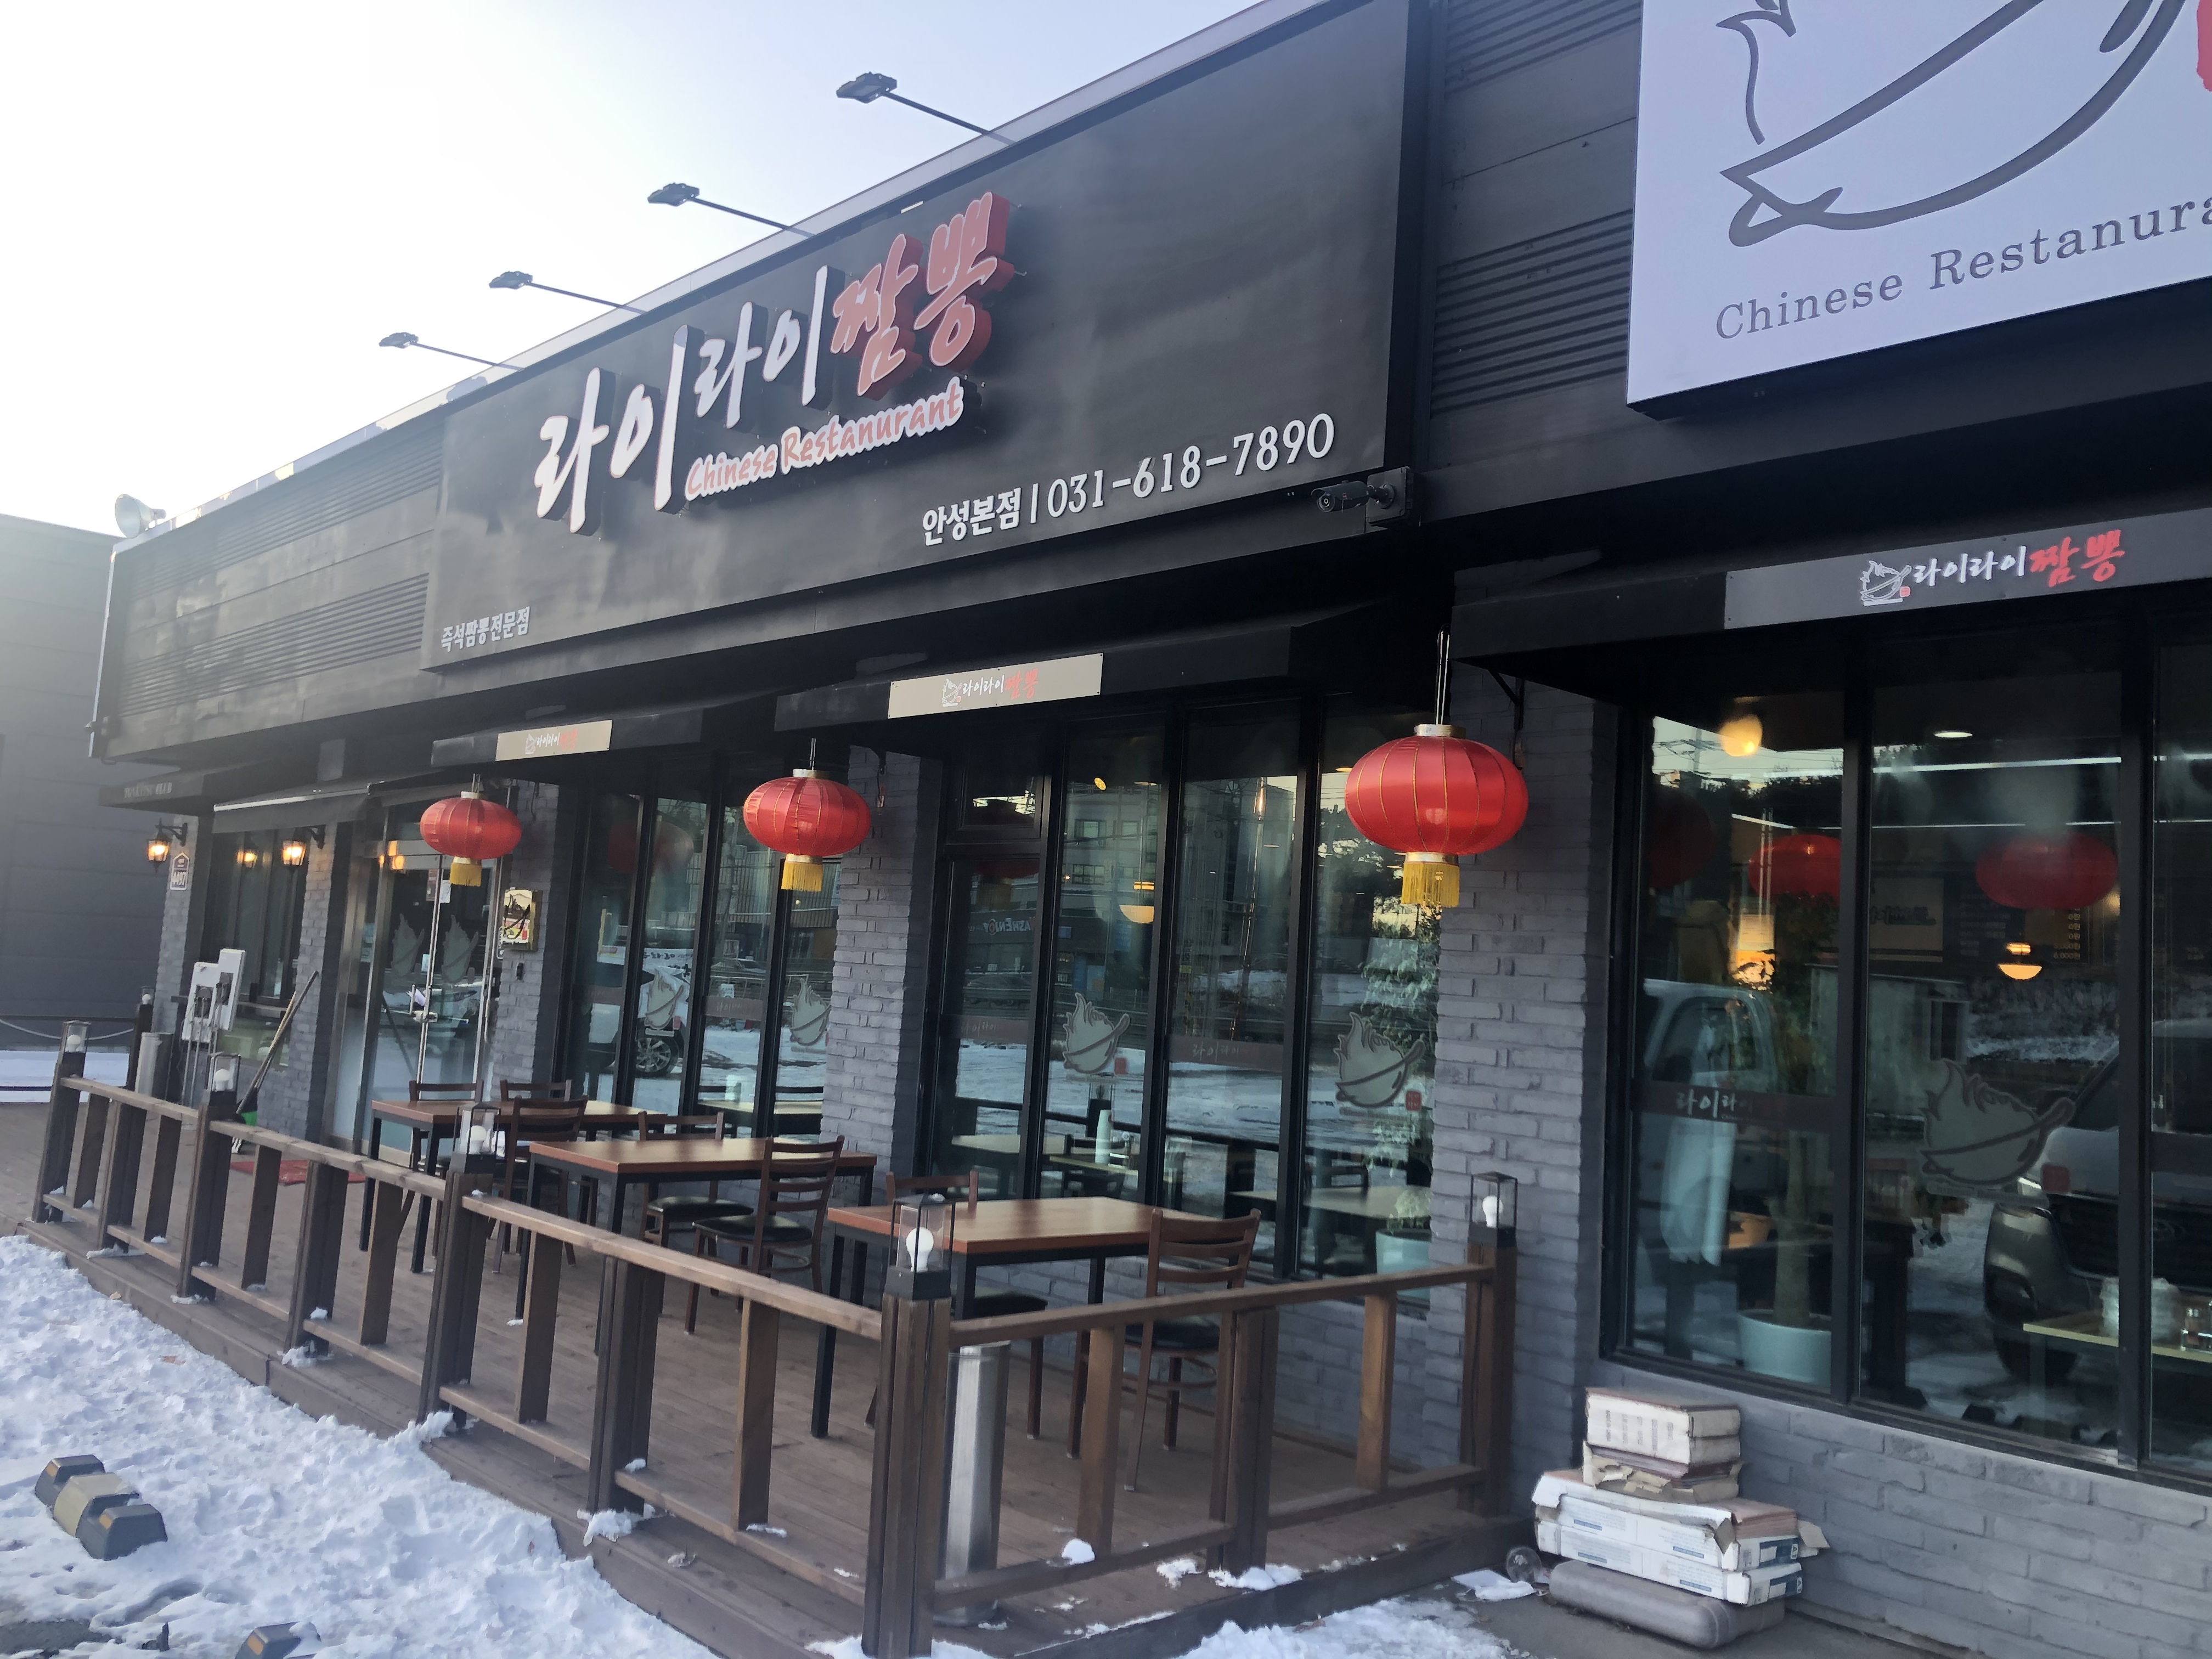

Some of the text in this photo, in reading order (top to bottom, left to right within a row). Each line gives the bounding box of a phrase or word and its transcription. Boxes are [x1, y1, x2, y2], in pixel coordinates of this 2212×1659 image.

[1716, 274, 1903, 339] Chinese
[686, 377, 964, 501] Chinese Restanurant
[922, 413, 1335, 546] 안성본점 031-618-7890
